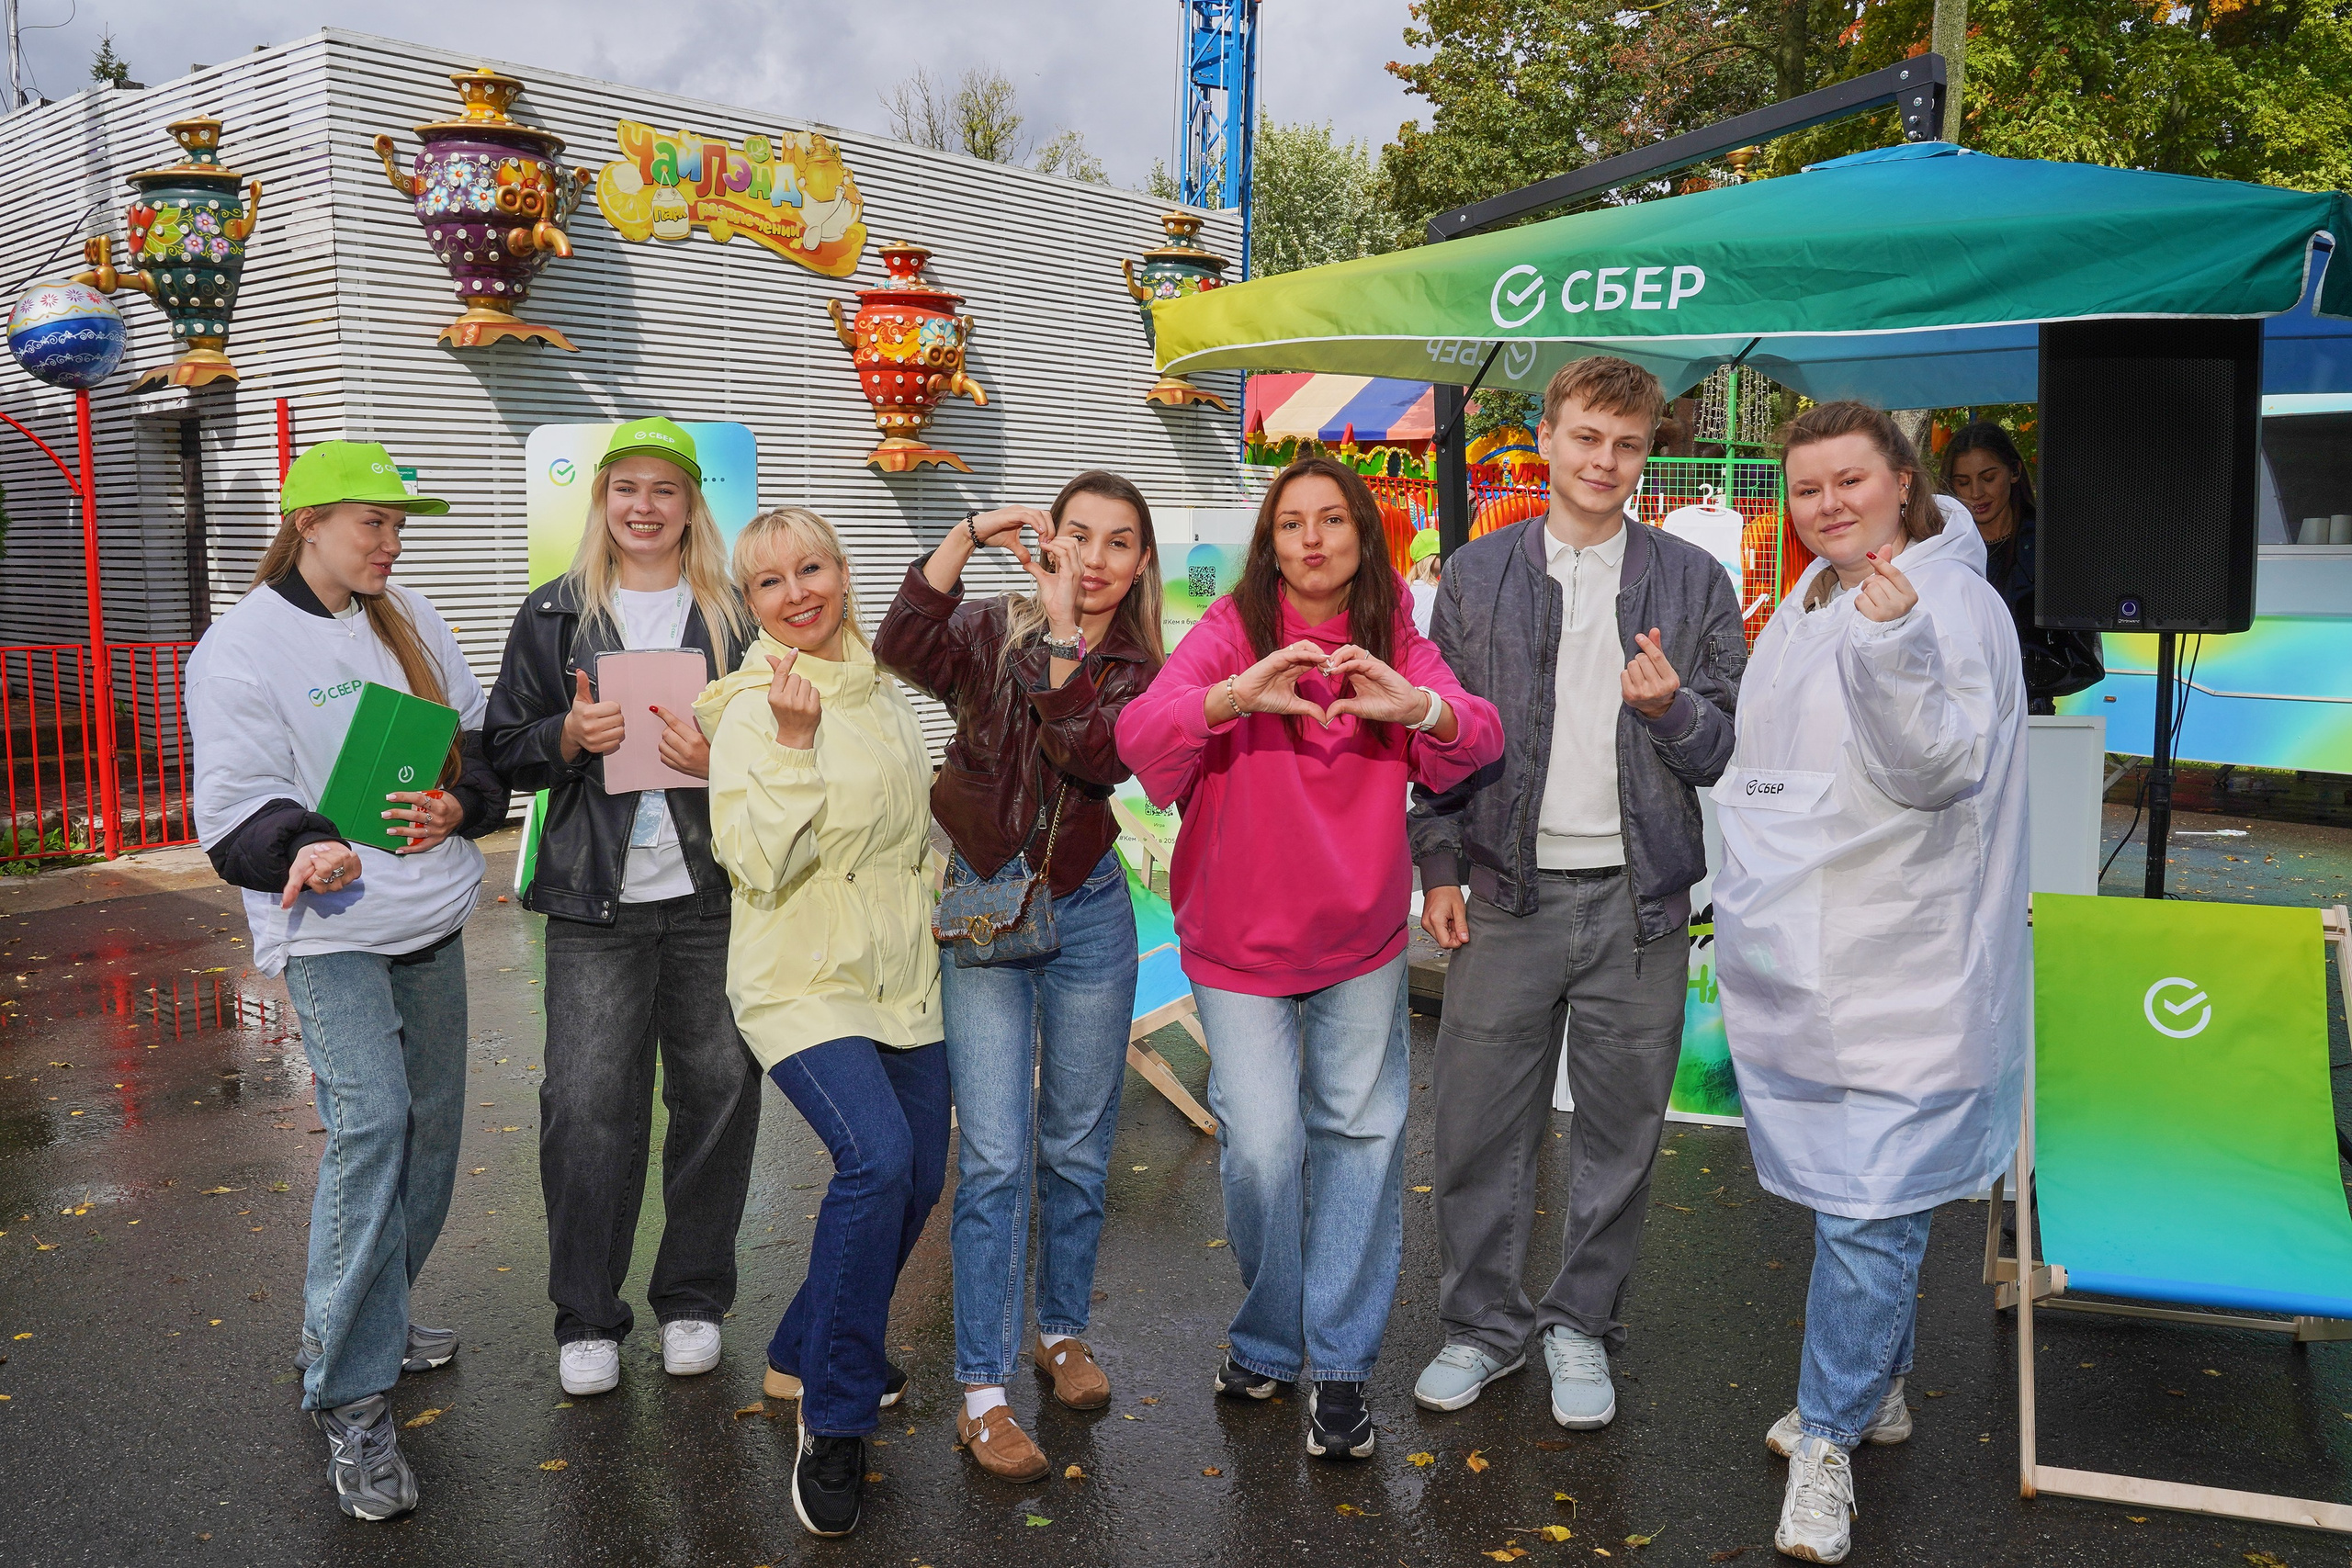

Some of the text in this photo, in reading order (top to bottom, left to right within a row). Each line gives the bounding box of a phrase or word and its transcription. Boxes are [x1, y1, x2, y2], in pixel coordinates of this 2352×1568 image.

[697, 201, 801, 238] развлечений
[1561, 265, 1706, 314] СБЕР
[649, 432, 675, 444] СБЕР
[328, 680, 362, 698] СБЕР
[1758, 784, 1784, 794] СБЕР
